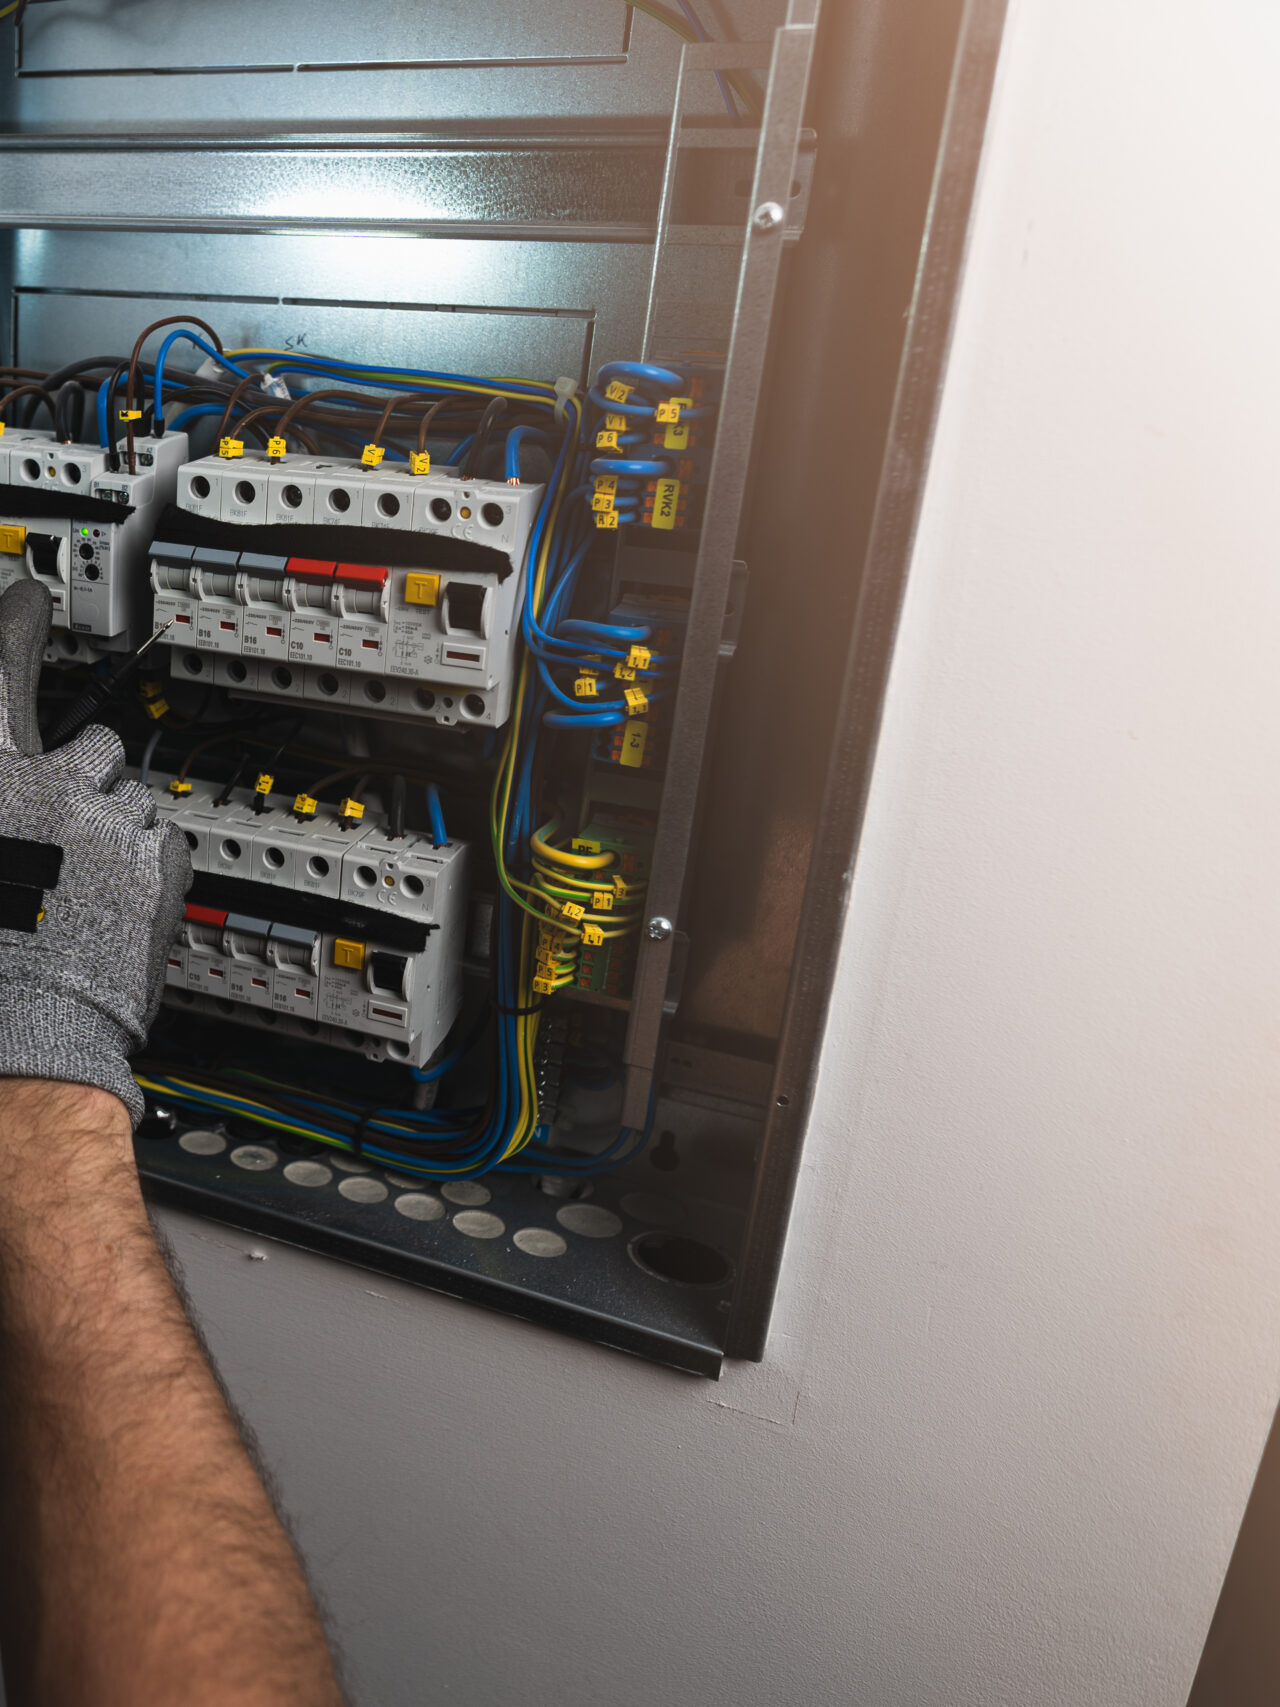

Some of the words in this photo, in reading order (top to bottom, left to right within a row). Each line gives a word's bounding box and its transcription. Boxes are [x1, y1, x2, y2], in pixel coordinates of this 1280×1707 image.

[660, 484, 675, 517] RVK2
[198, 628, 211, 639] B16
[244, 635, 257, 645] B16
[290, 641, 304, 650] C10
[338, 647, 352, 657] C10
